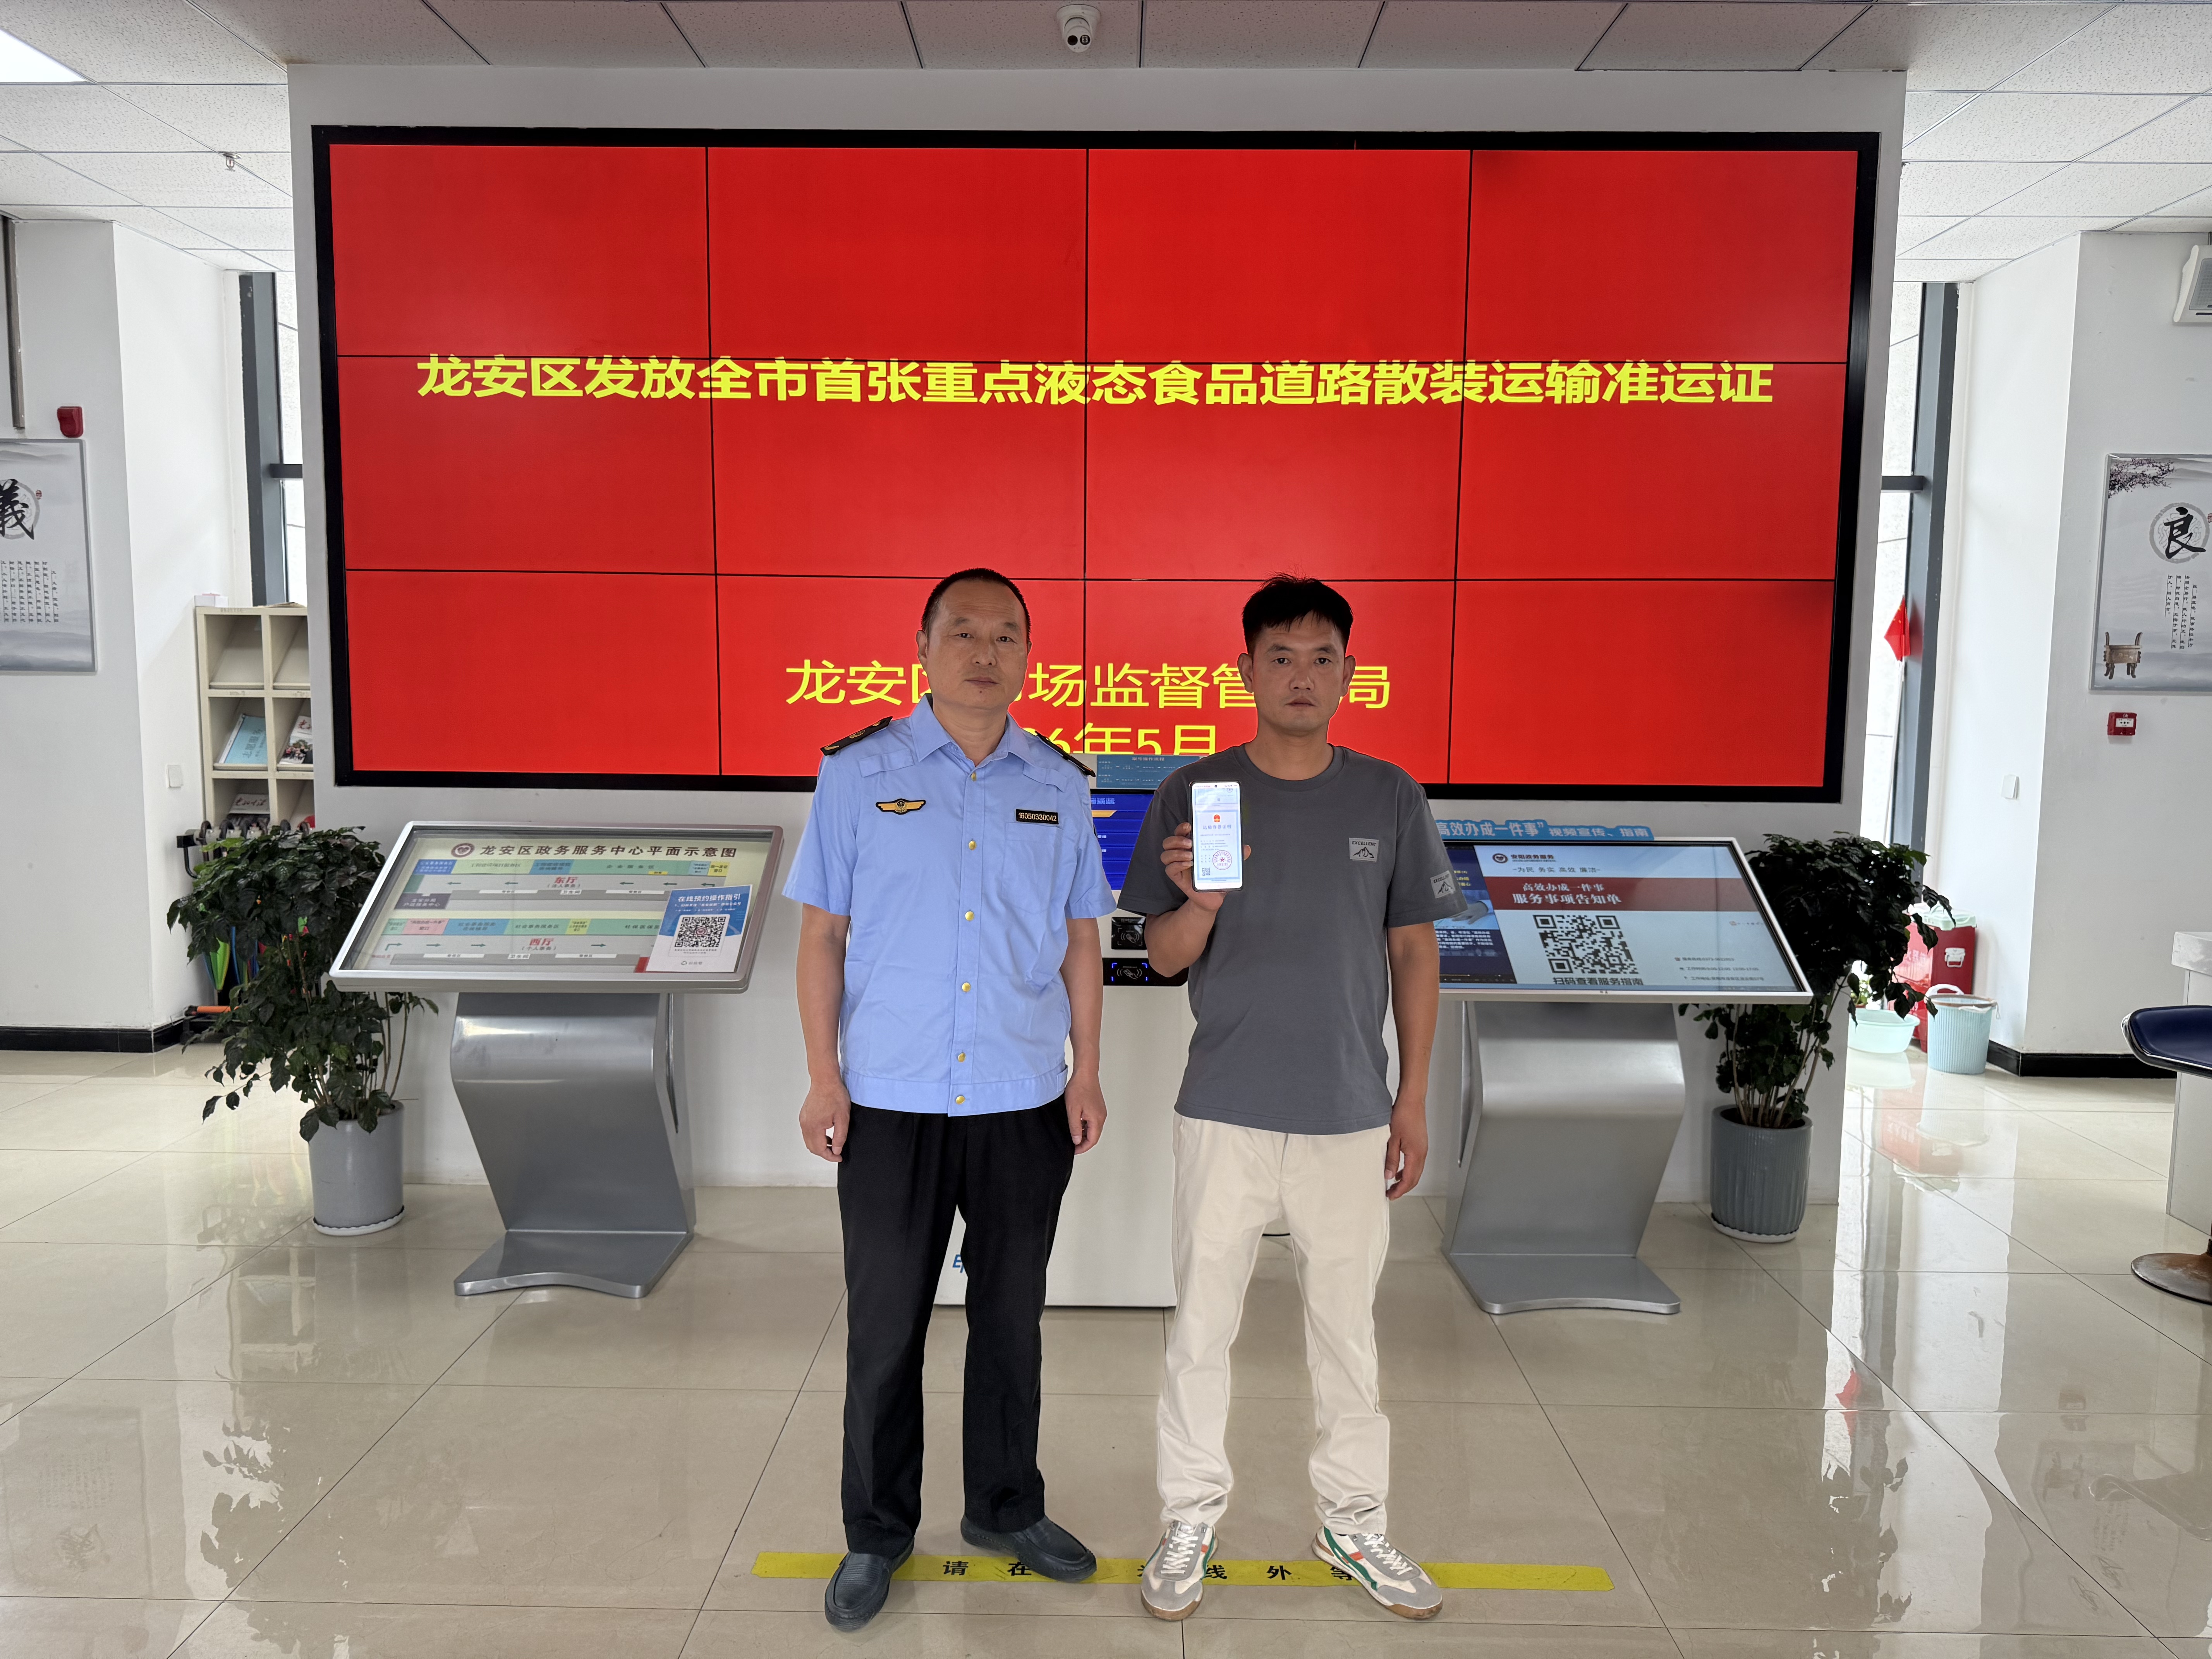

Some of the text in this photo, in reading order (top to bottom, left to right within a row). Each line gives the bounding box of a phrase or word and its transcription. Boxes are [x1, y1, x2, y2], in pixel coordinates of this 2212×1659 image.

[417, 354, 1774, 405] 龙安区发放全市首张重点液态食品道路散装运输准运证
[2164, 507, 2206, 560] 良
[786, 659, 1390, 709] 龙安场监督管局
[1018, 812, 1057, 822] 16050330042
[1549, 827, 1649, 837] 视频宣传、指南
[479, 845, 737, 858] 龙安区政务服务中心平面示意图
[1522, 883, 1605, 891] 高效办成一件事
[678, 893, 740, 902] 在线预约操作指引
[1513, 893, 1621, 905] 服务事项告知单
[529, 938, 554, 946] 西厅
[1553, 977, 1644, 986] 扫码查看服务指南
